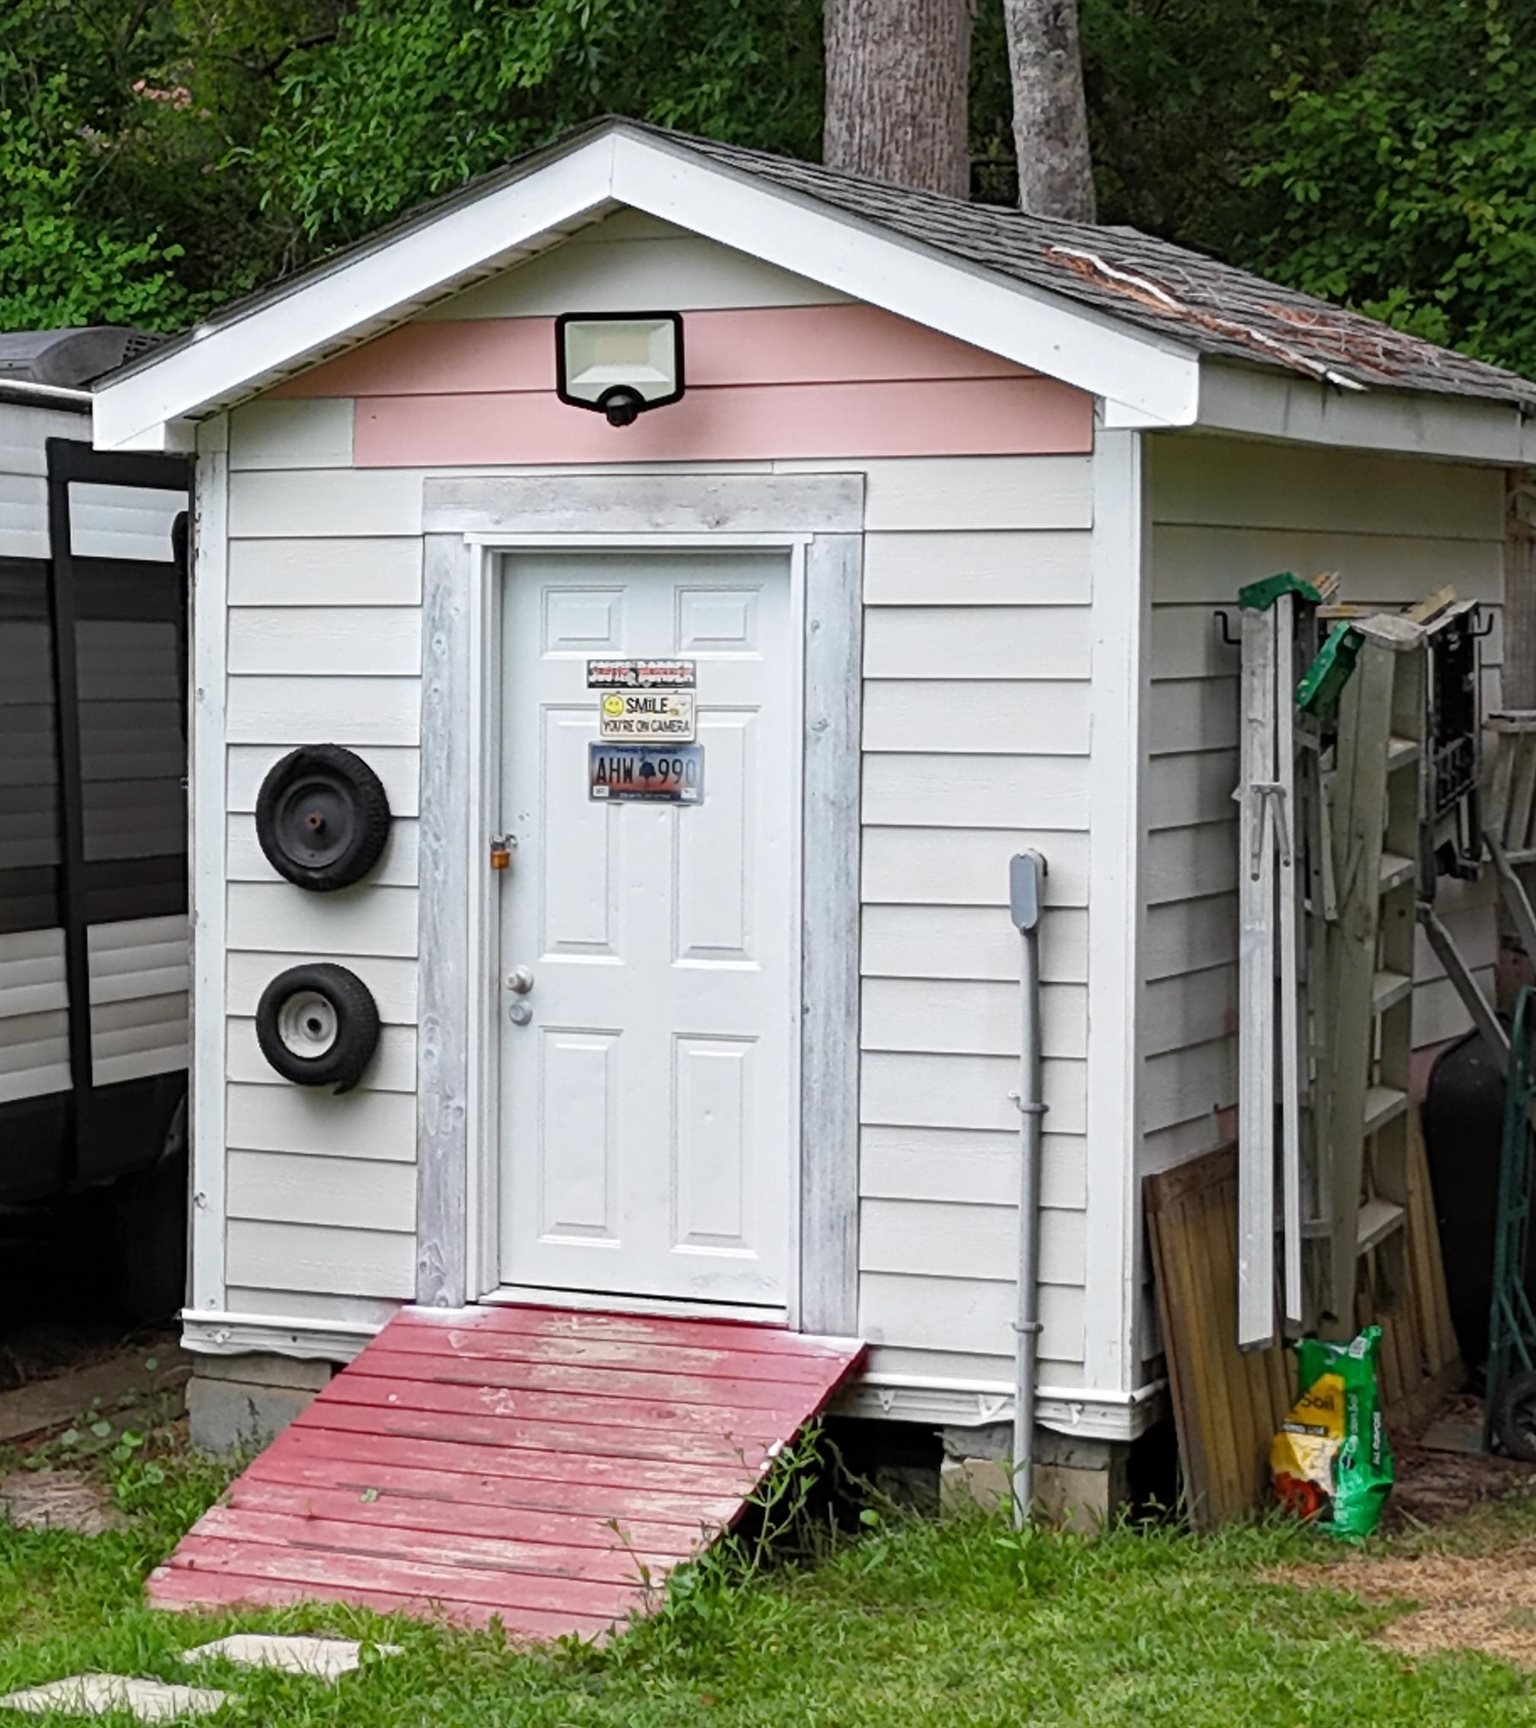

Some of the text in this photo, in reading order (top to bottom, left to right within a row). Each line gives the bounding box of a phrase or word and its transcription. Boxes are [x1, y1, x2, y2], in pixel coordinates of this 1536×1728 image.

[626, 697, 670, 714] SMILE
[636, 719, 650, 733] ON
[651, 719, 690, 733] CAMERA
[596, 757, 634, 784] AHW
